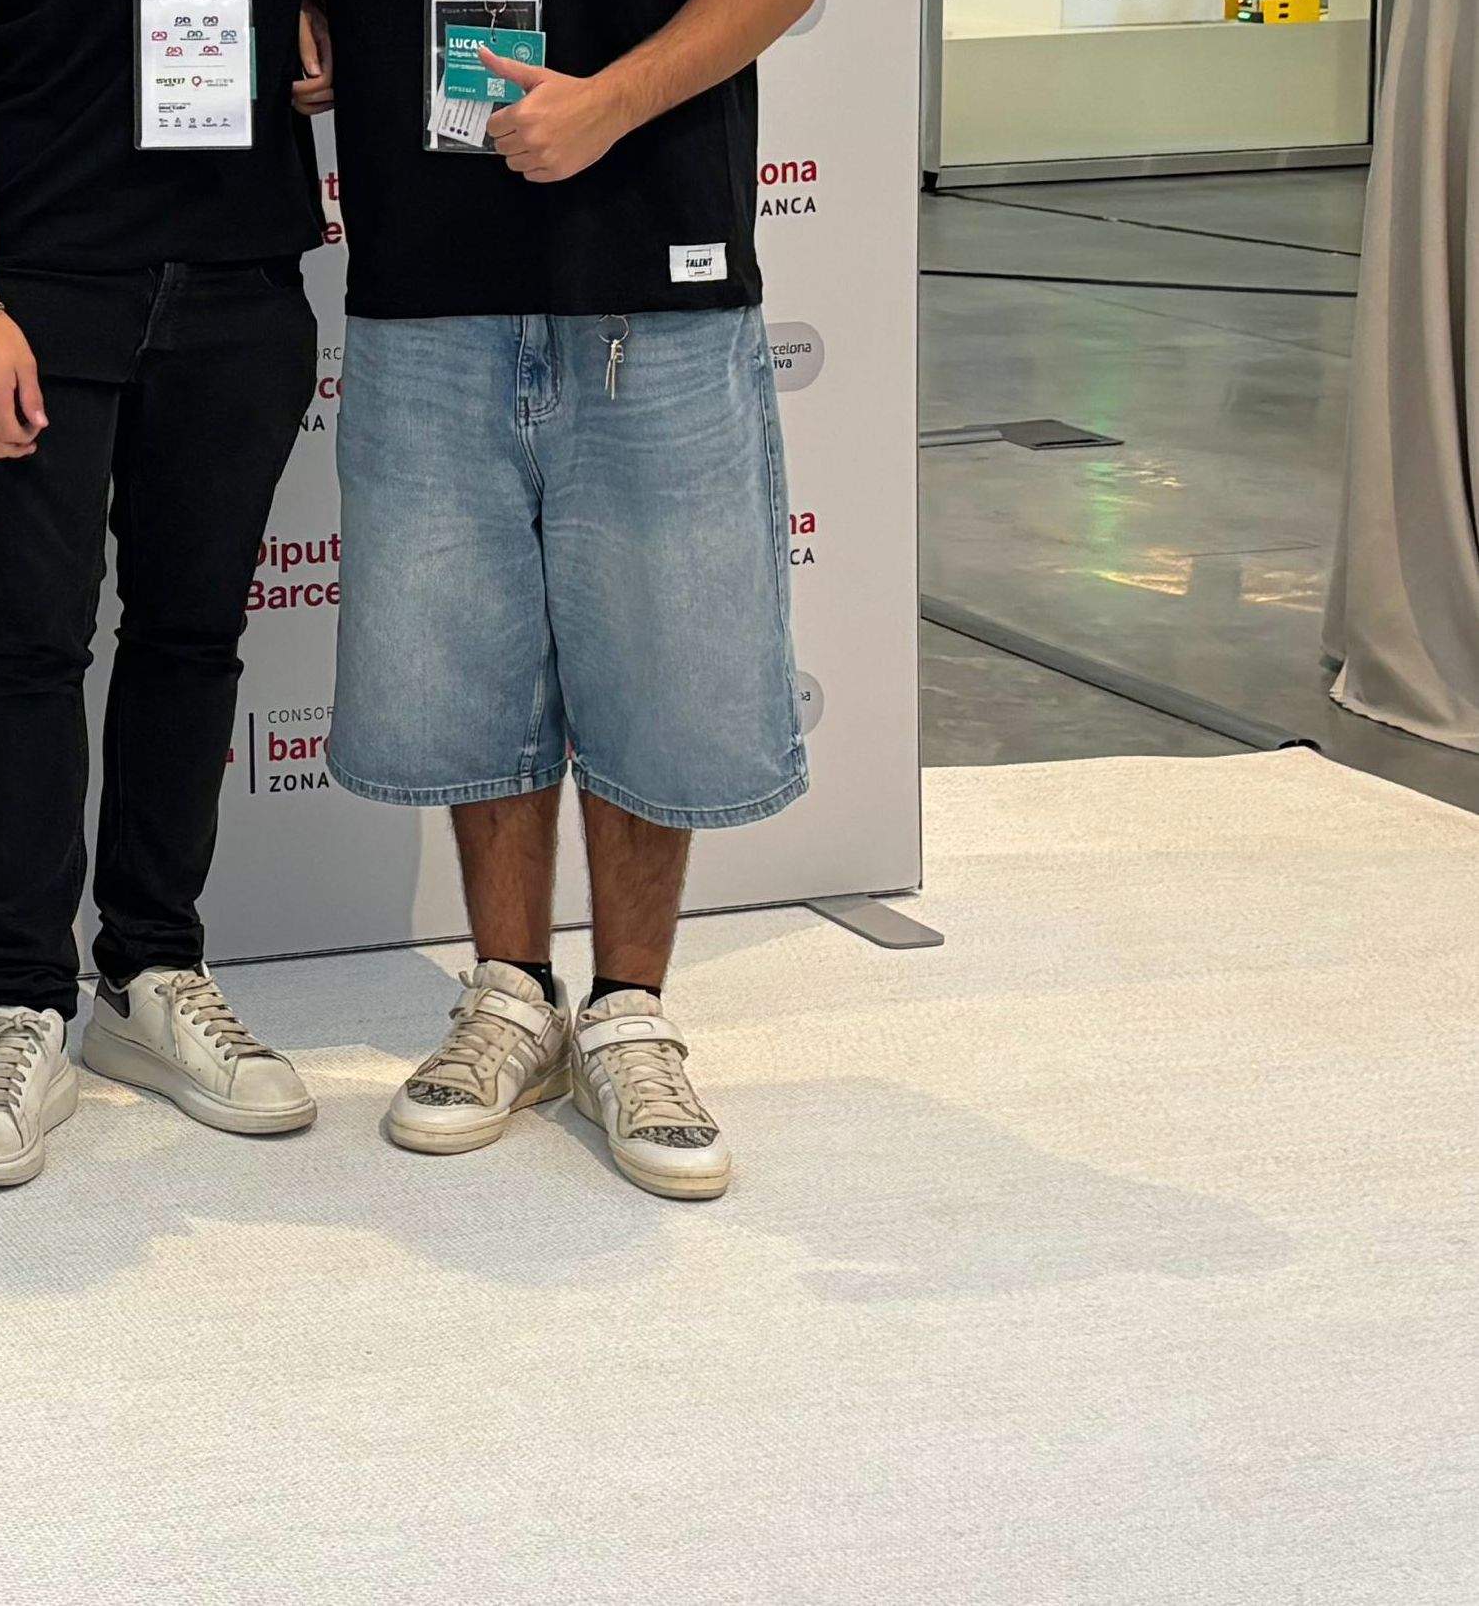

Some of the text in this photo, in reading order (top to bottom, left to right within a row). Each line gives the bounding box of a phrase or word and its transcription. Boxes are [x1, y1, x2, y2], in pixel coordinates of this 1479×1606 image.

[760, 197, 816, 217] ANCA
[686, 257, 712, 268] TALENT
[245, 581, 341, 611] Barce
[270, 772, 330, 792] ZONA
